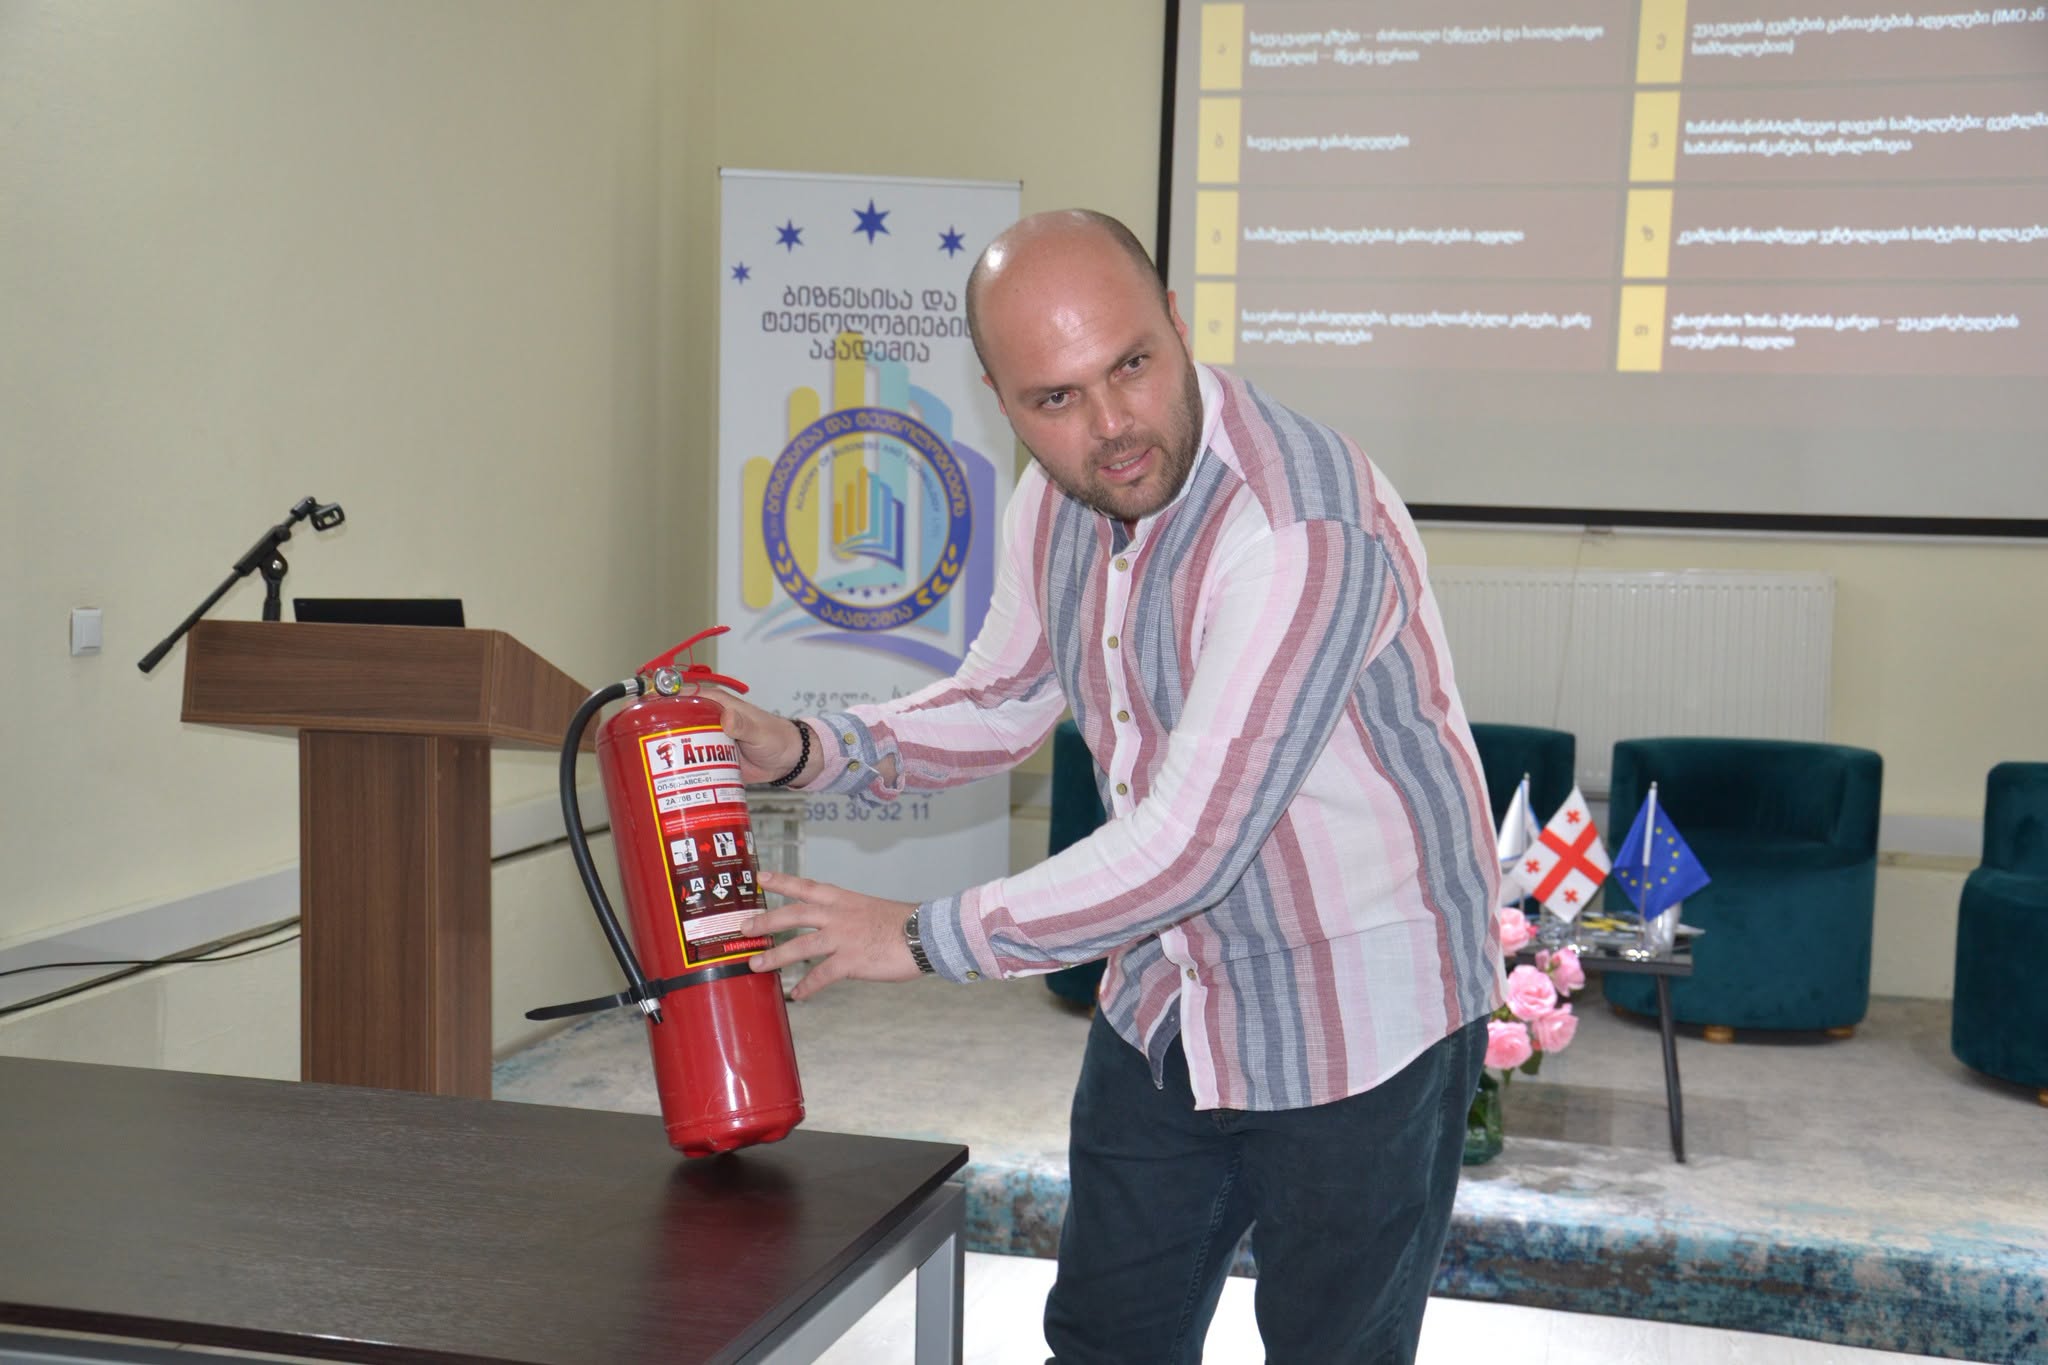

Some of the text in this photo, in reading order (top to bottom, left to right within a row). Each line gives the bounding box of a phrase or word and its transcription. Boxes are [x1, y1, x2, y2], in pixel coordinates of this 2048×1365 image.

[783, 285, 957, 312] ბიზნესისა და
[810, 339, 930, 363] აკადემია
[683, 743, 737, 765] Атлант
[878, 802, 902, 821] 32
[912, 801, 930, 820] 11
